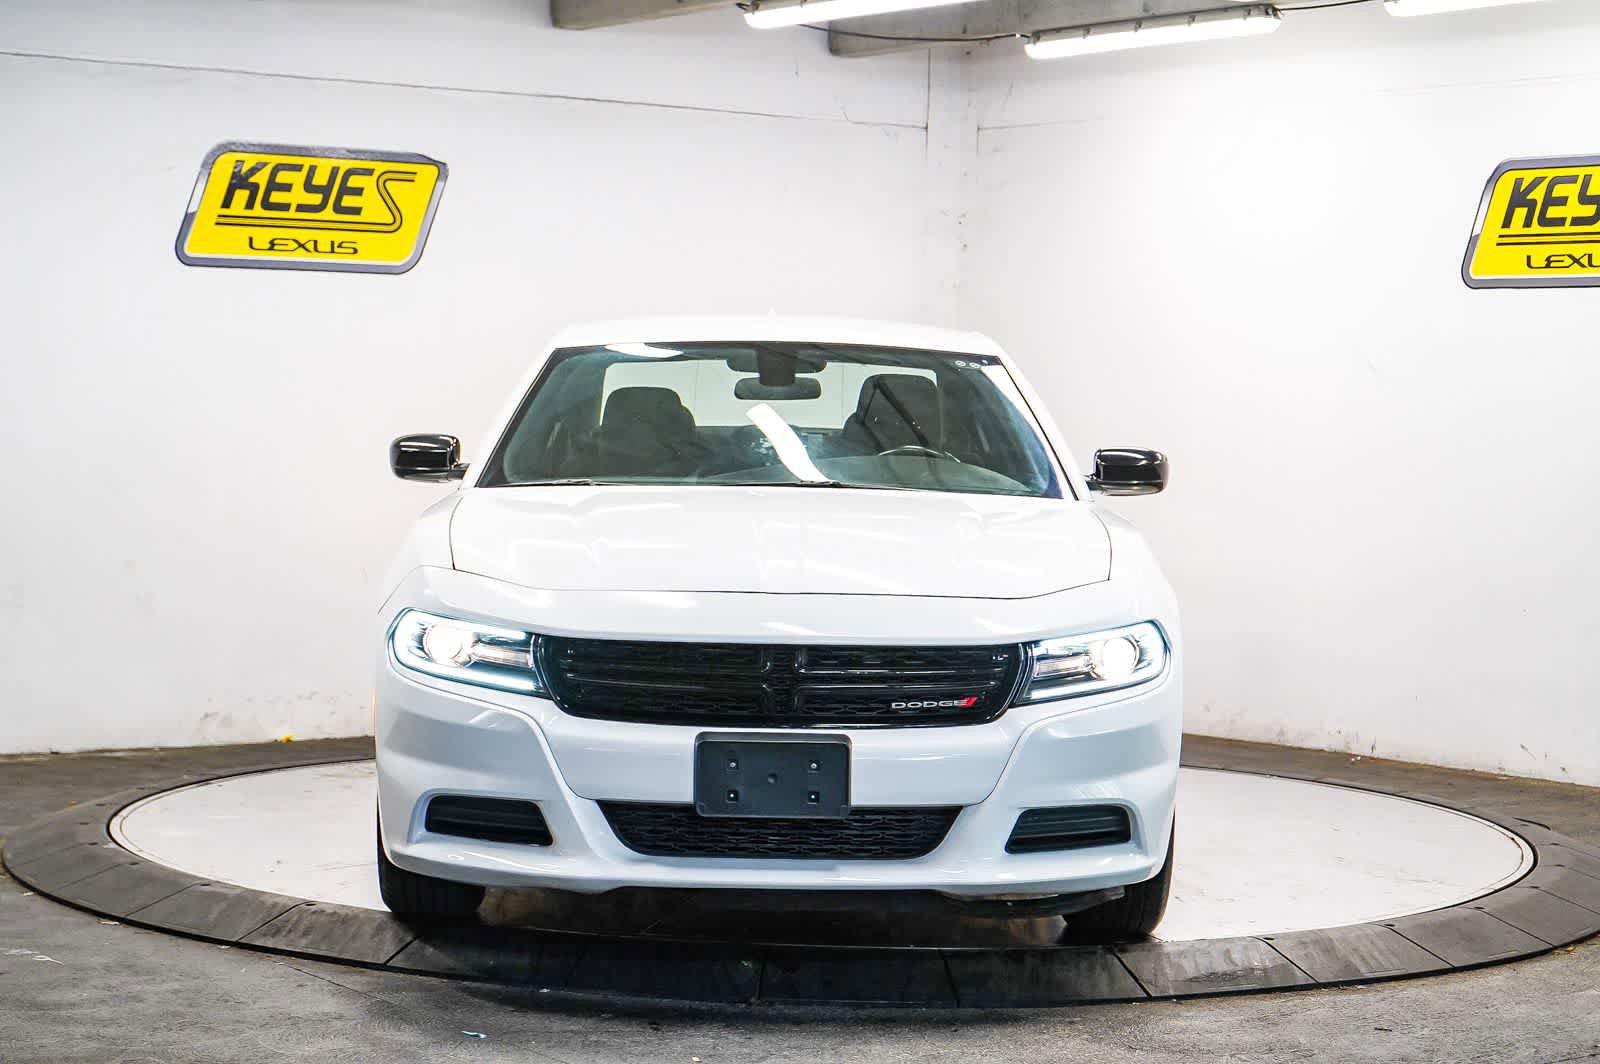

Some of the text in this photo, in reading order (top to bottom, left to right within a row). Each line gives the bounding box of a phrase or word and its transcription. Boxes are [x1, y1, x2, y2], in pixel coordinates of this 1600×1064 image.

[220, 160, 417, 232] KEYES
[248, 236, 358, 254] LEXUS
[891, 699, 967, 709] DODGE
